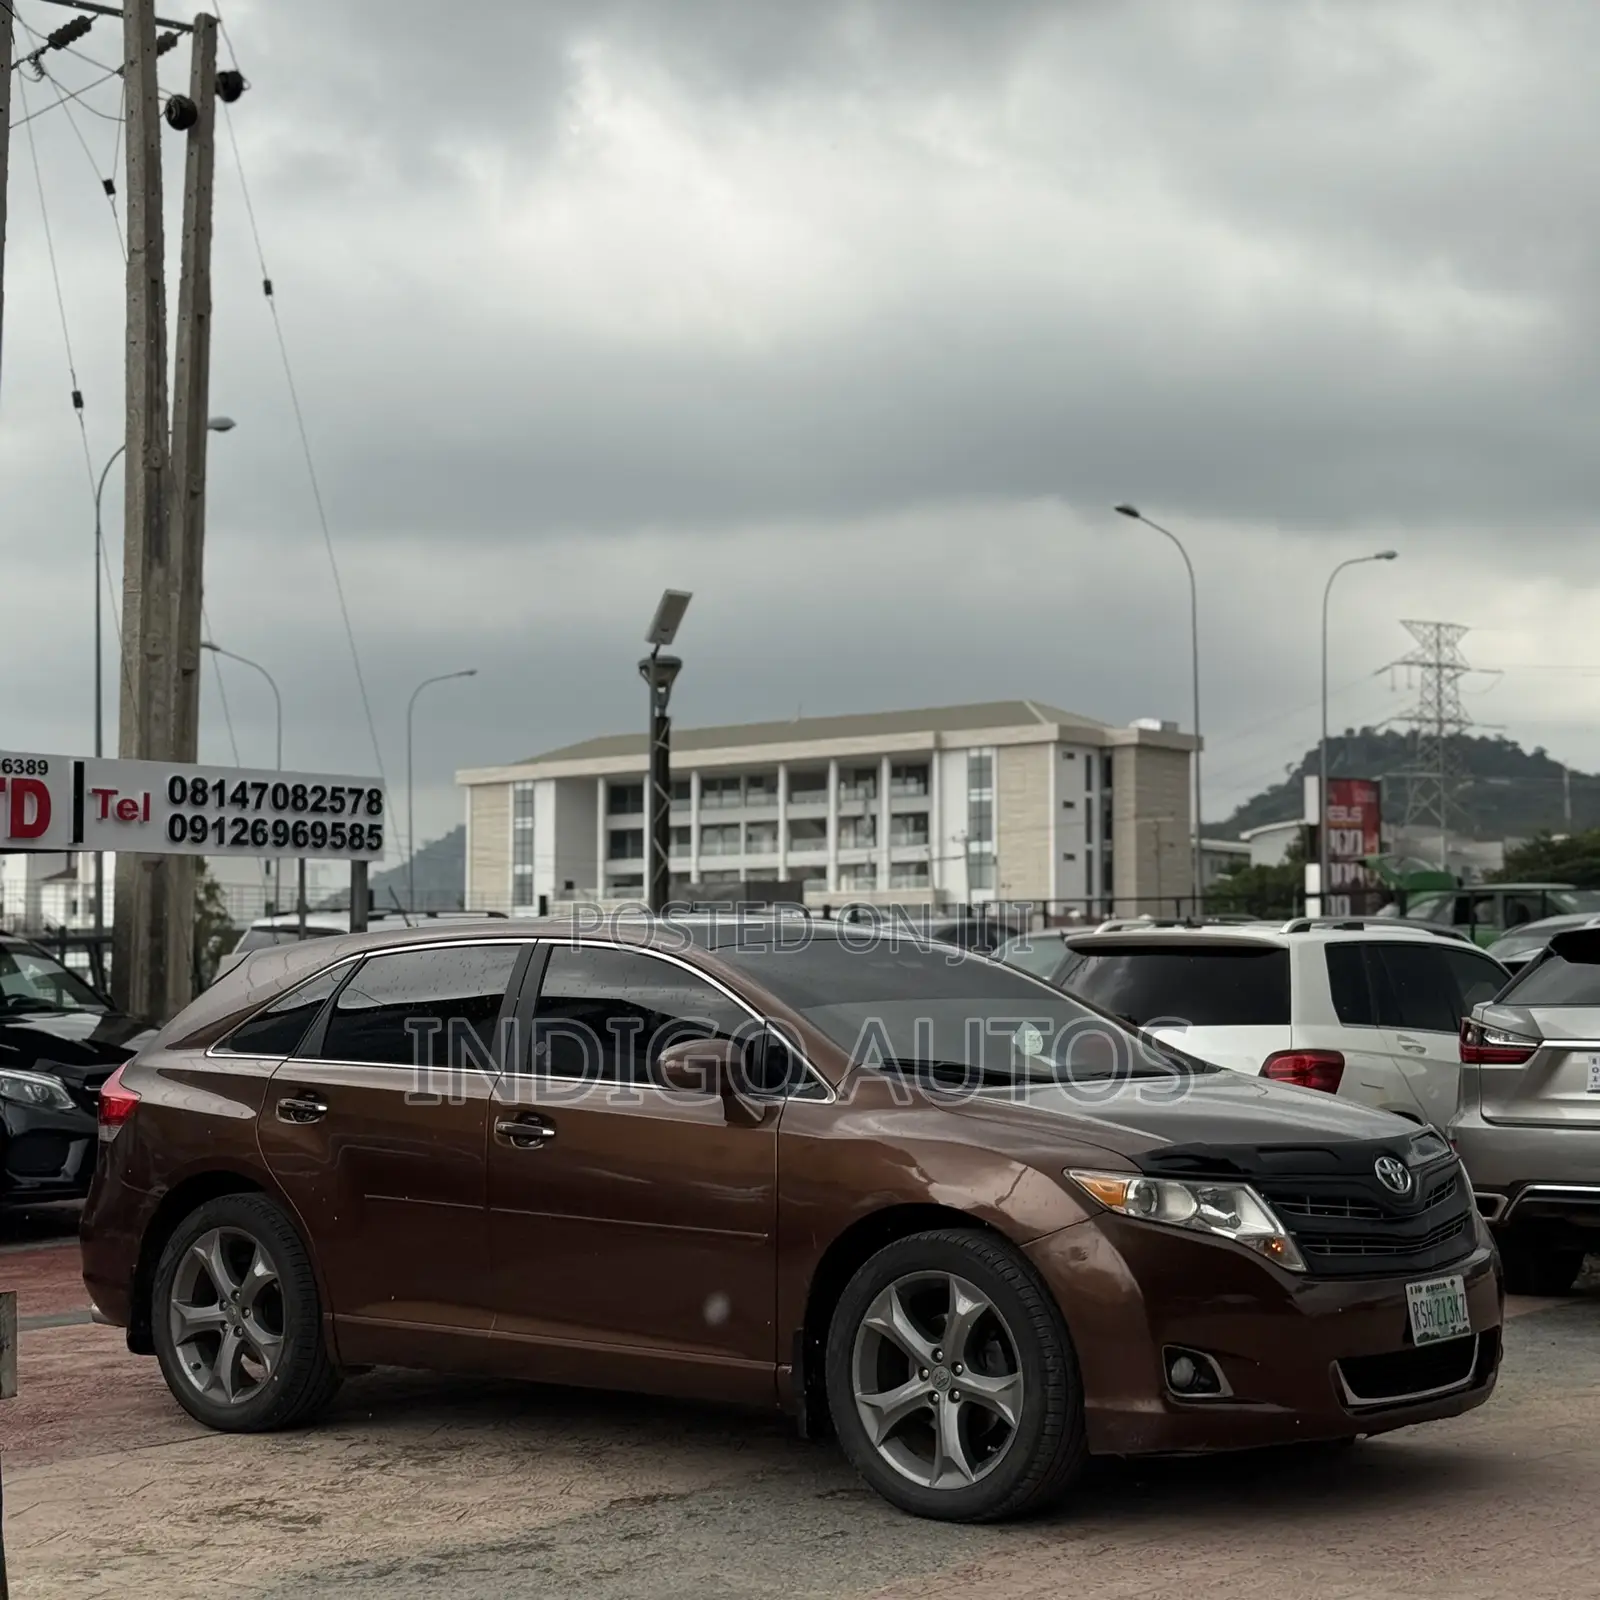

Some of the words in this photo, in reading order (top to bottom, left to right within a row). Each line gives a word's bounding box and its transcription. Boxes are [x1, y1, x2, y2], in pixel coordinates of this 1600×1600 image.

[0, 777, 52, 839] D
[91, 788, 151, 822] Tel
[168, 775, 383, 816] 08147082578
[168, 813, 383, 851] 09126969585
